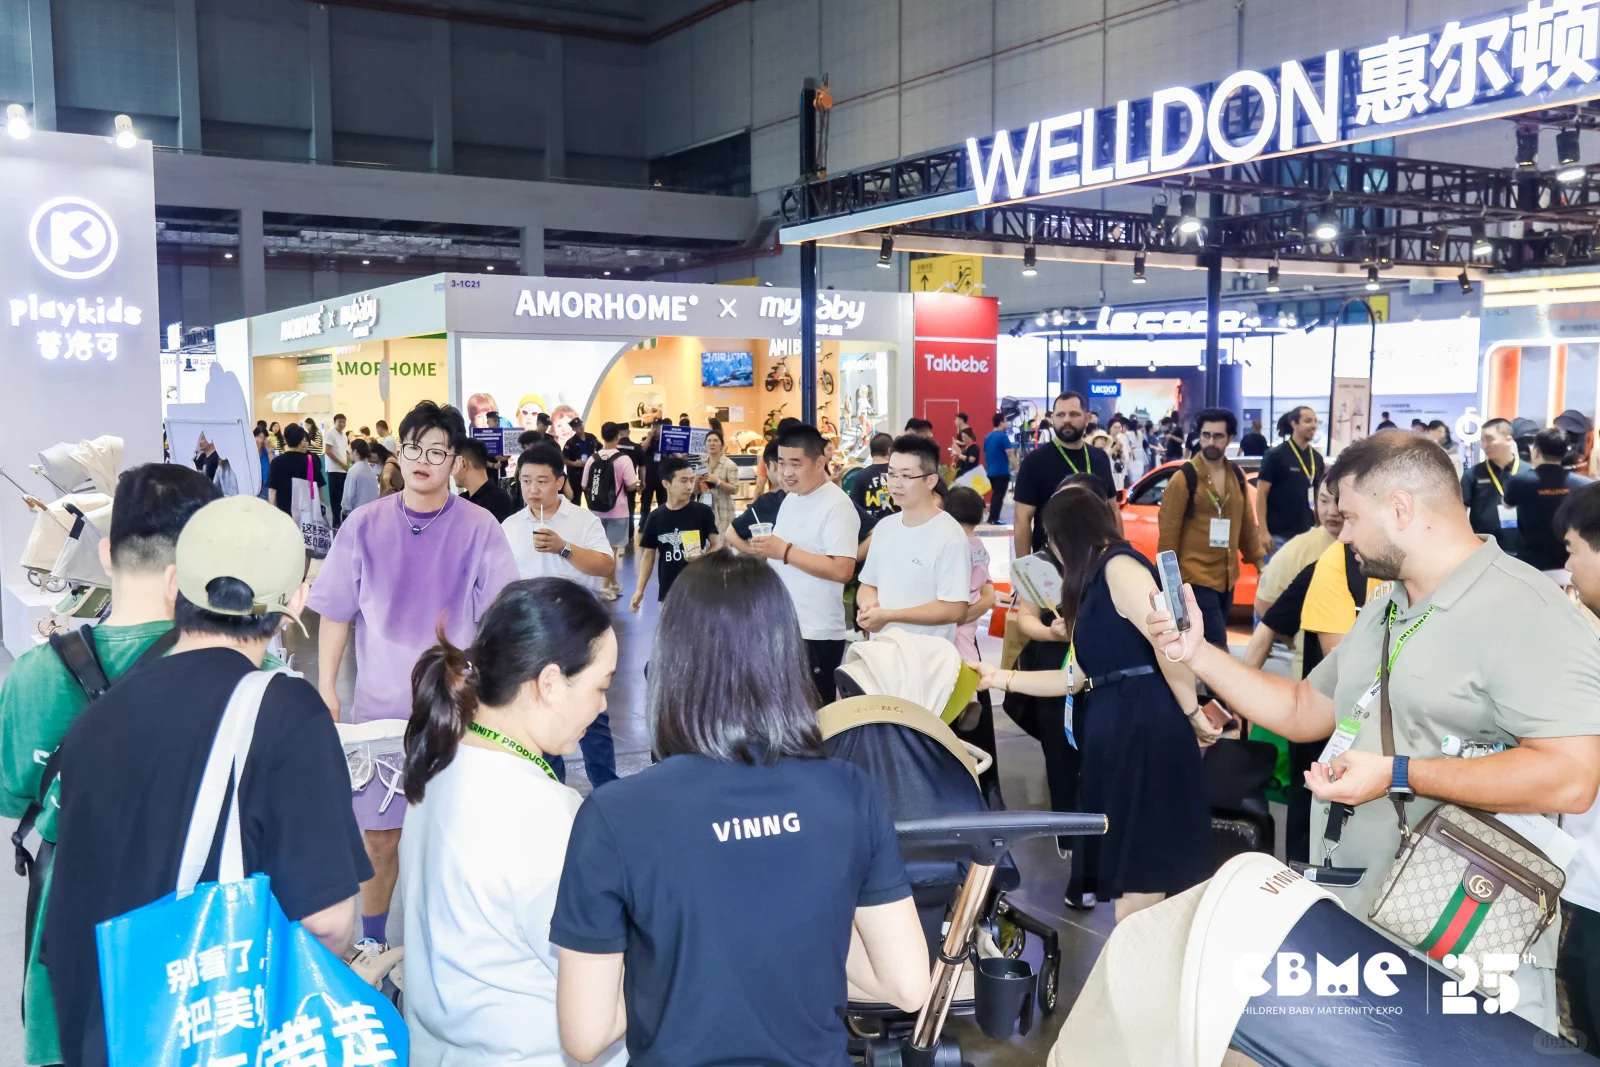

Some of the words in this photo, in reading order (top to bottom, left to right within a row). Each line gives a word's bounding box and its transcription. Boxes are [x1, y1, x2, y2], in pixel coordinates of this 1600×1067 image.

[1355, 0, 1600, 126] 惠尔顿
[966, 49, 1341, 205] WELLDON
[451, 280, 481, 289] 3-1C21
[9, 293, 143, 327] playkids
[515, 289, 688, 322] AMORHOME
[759, 293, 866, 330] myaby
[924, 354, 989, 373] Takbebe
[665, 550, 686, 562] BO
[501, 736, 549, 772] PRODUCTS
